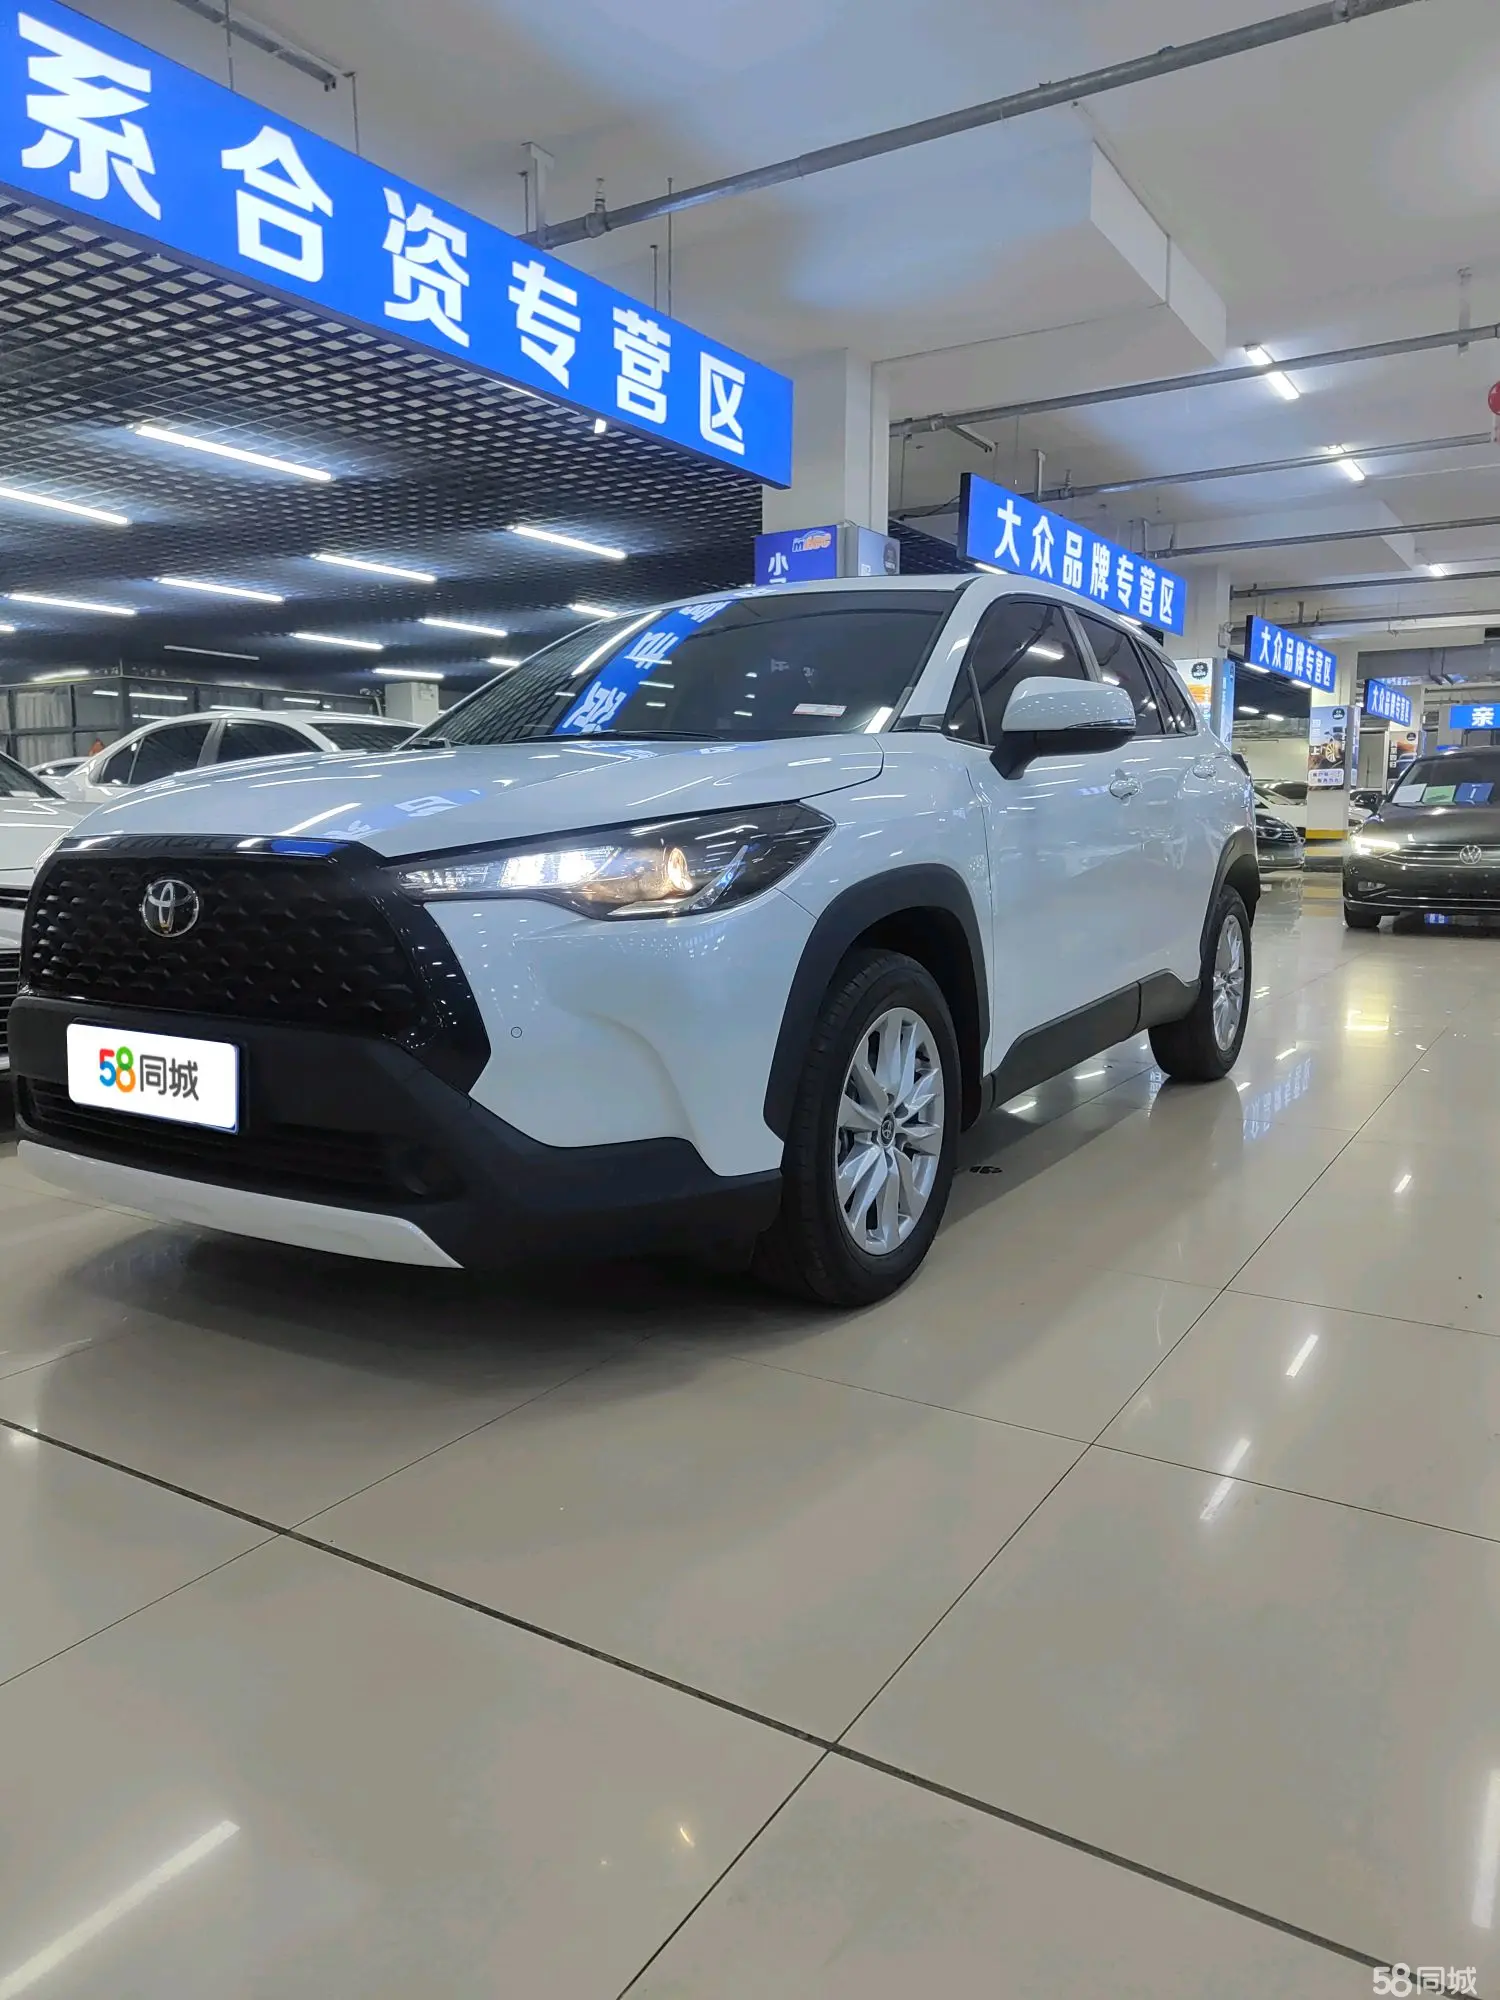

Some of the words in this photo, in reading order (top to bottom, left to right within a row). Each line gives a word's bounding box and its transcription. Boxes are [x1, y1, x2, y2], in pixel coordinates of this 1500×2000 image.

[18, 11, 747, 455] 系合资专营区
[994, 499, 1175, 625] 大众品牌专营区
[1259, 625, 1332, 687] 大众品牌专营区
